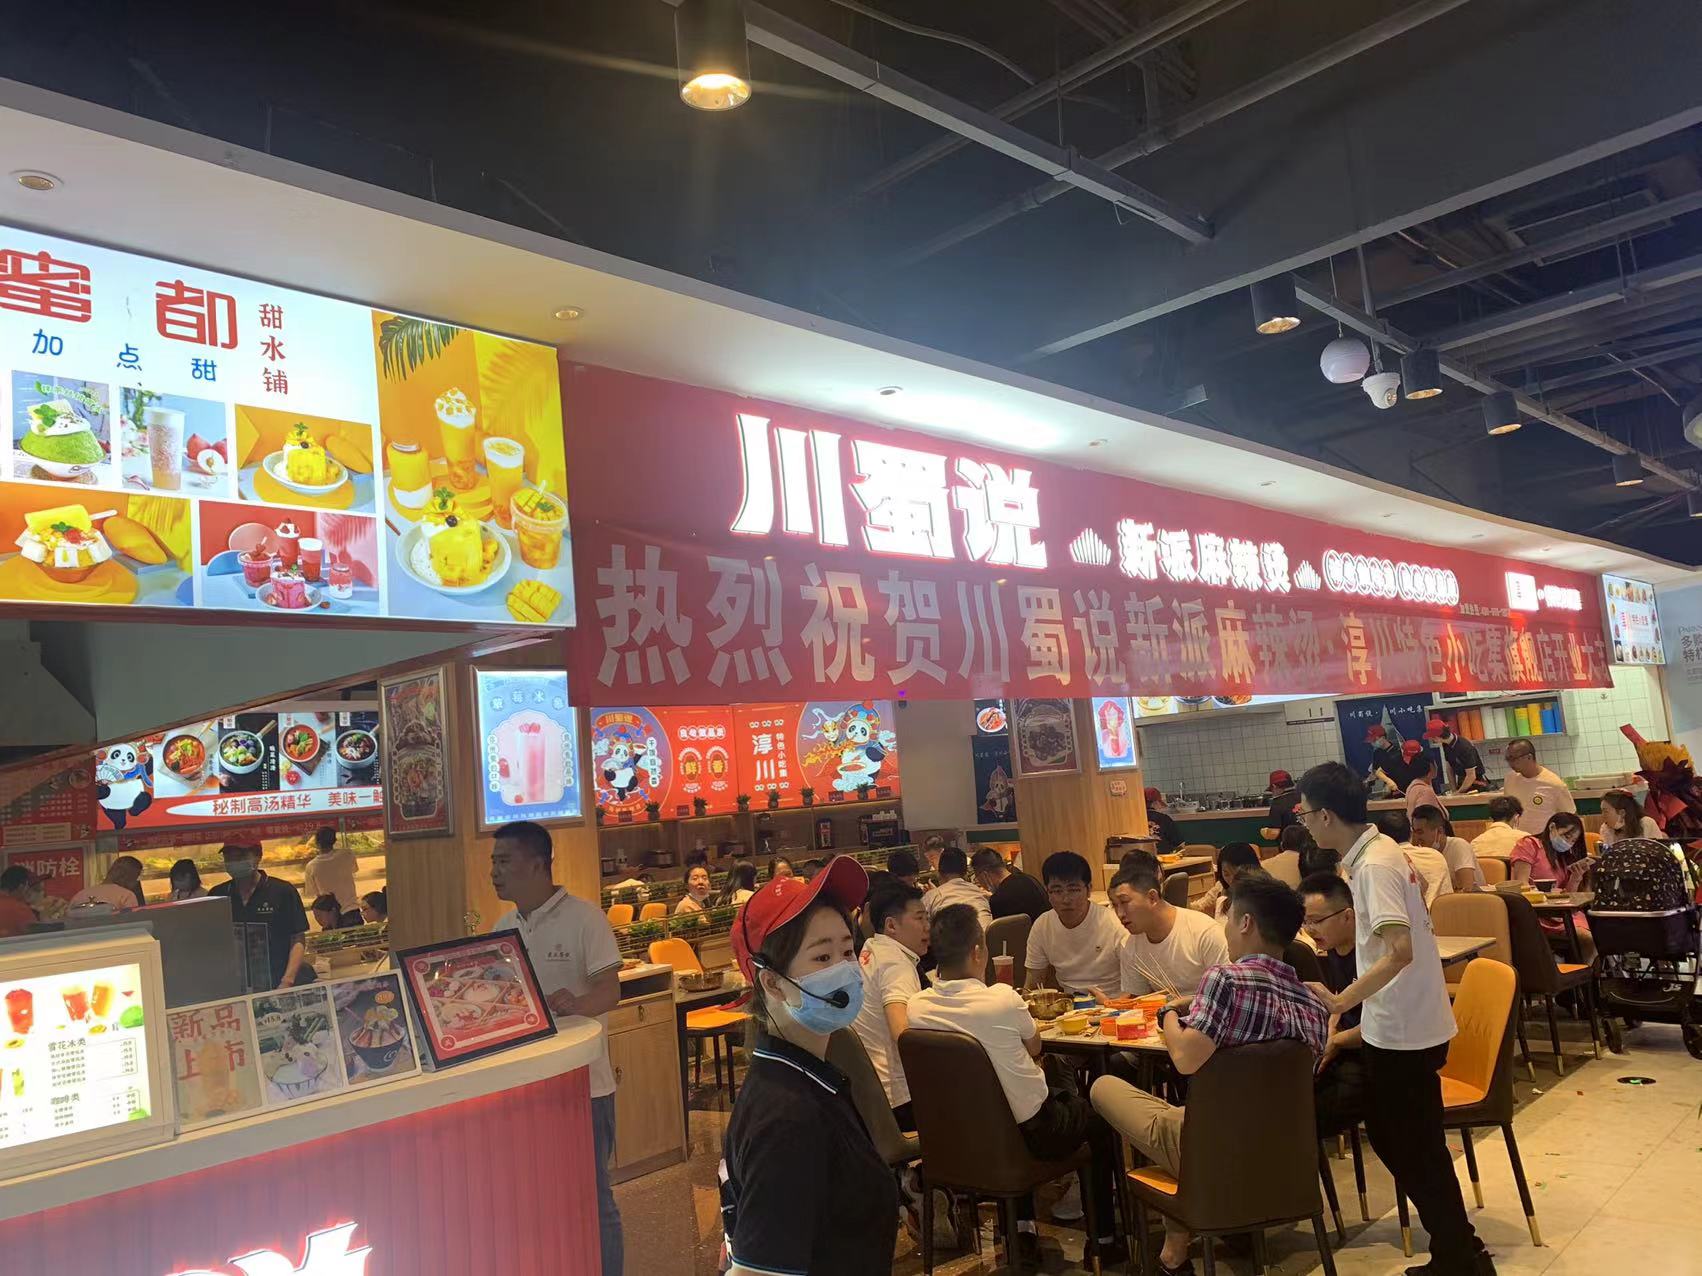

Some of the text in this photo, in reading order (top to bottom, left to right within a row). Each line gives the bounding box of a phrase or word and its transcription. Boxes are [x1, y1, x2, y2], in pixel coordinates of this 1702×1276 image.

[32, 328, 218, 383] 加点甜
[258, 303, 288, 395] 甜水铺
[729, 412, 1048, 569] 川蜀说
[752, 733, 776, 781] 淳川
[212, 794, 312, 816] 秘制高汤精华
[171, 1004, 242, 1042] 新品
[178, 1039, 246, 1082] 上市
